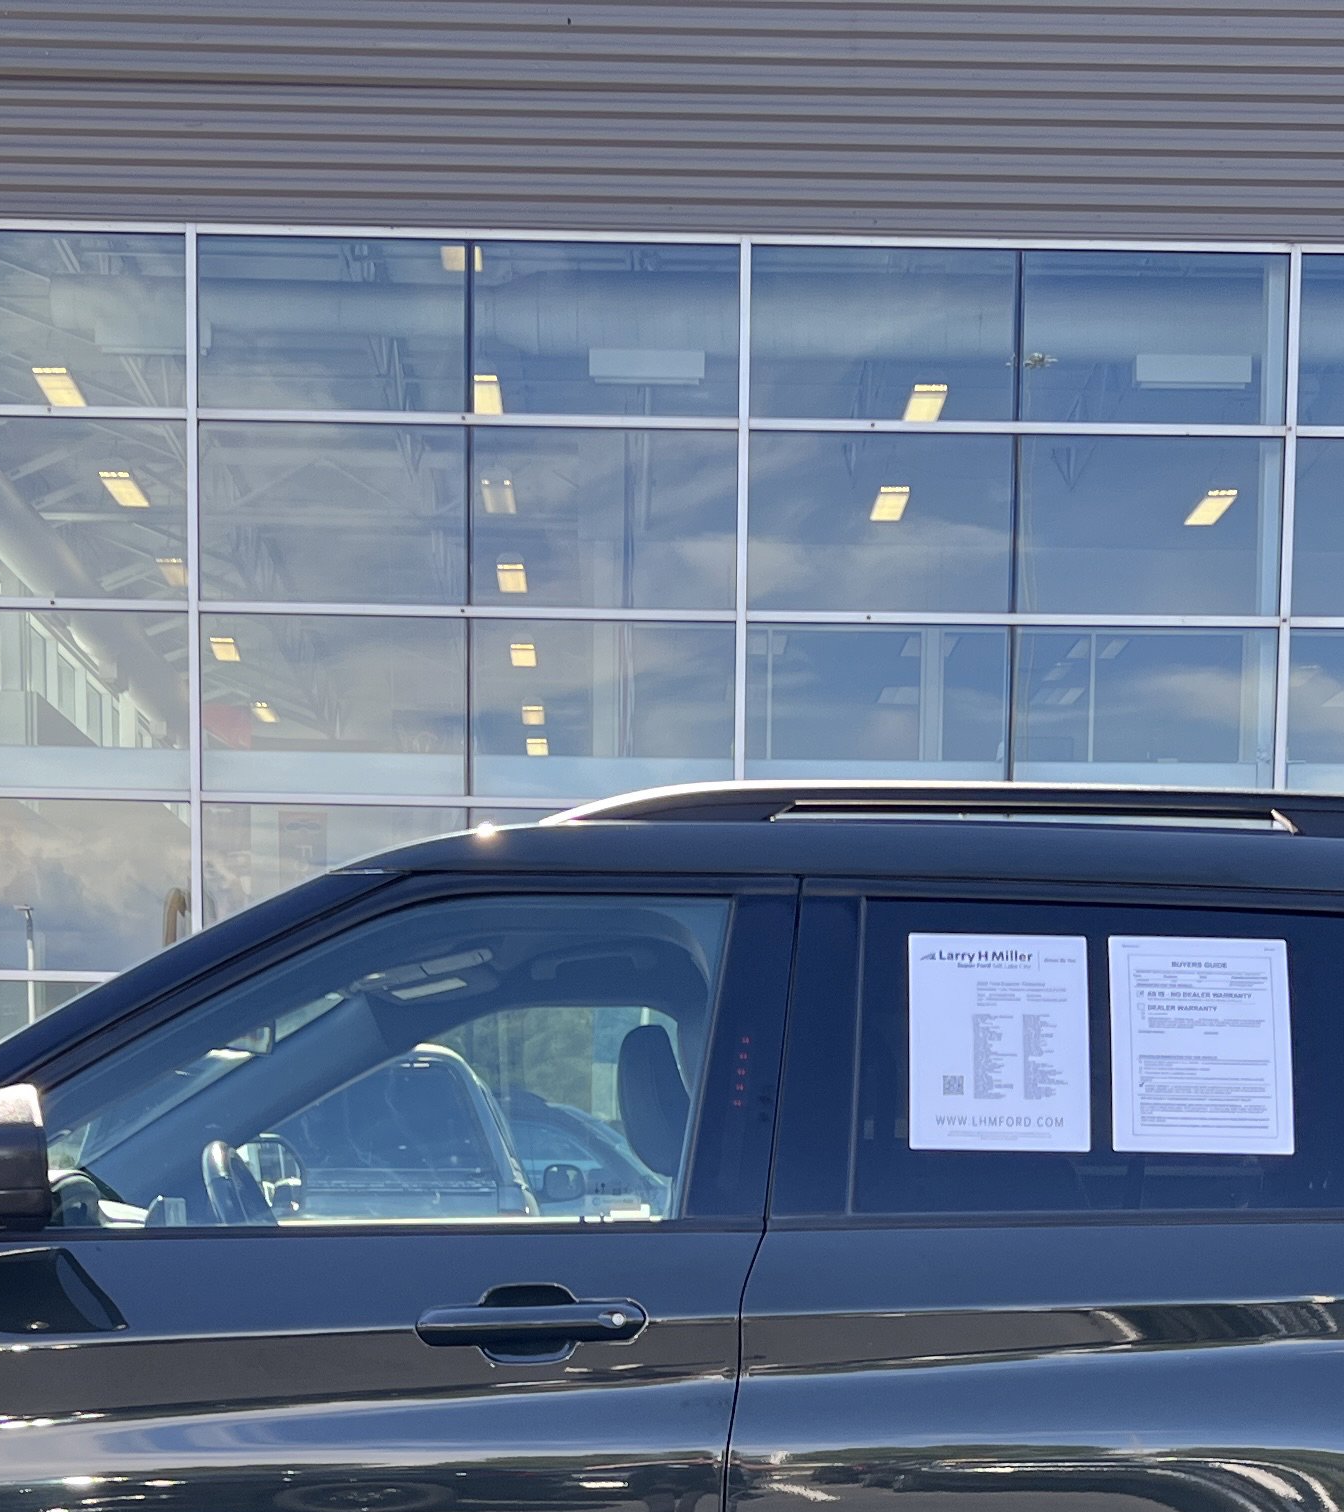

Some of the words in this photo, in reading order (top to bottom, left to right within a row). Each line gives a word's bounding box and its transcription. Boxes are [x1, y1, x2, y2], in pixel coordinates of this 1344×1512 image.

[939, 949, 975, 963] Larry
[978, 950, 988, 961] H
[991, 950, 1033, 962] Miller
